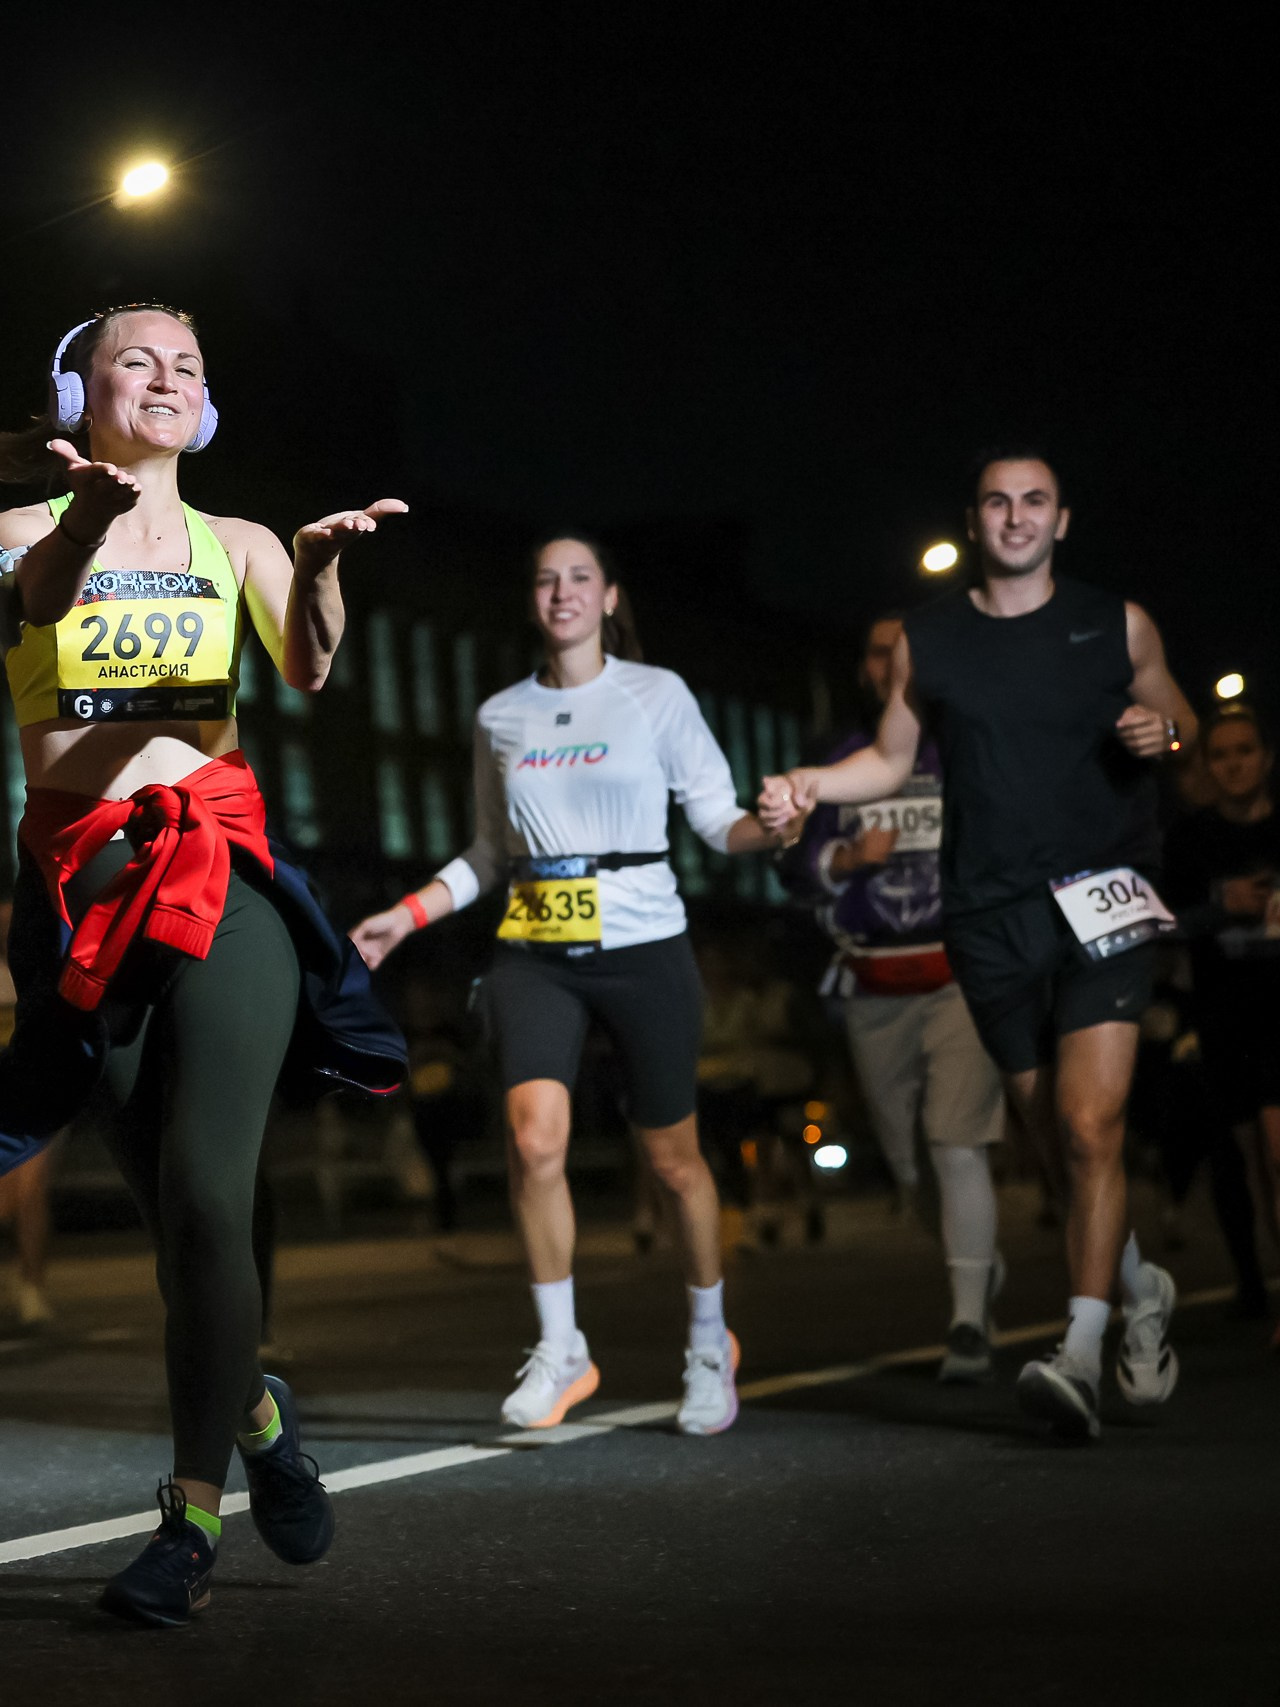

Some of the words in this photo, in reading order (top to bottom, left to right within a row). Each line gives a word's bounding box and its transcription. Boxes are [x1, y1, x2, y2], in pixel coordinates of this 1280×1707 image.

[80, 611, 204, 661] 2699
[98, 663, 189, 679] АНАСТАСИЯ
[74, 694, 94, 719] G
[517, 742, 608, 769] AVITO
